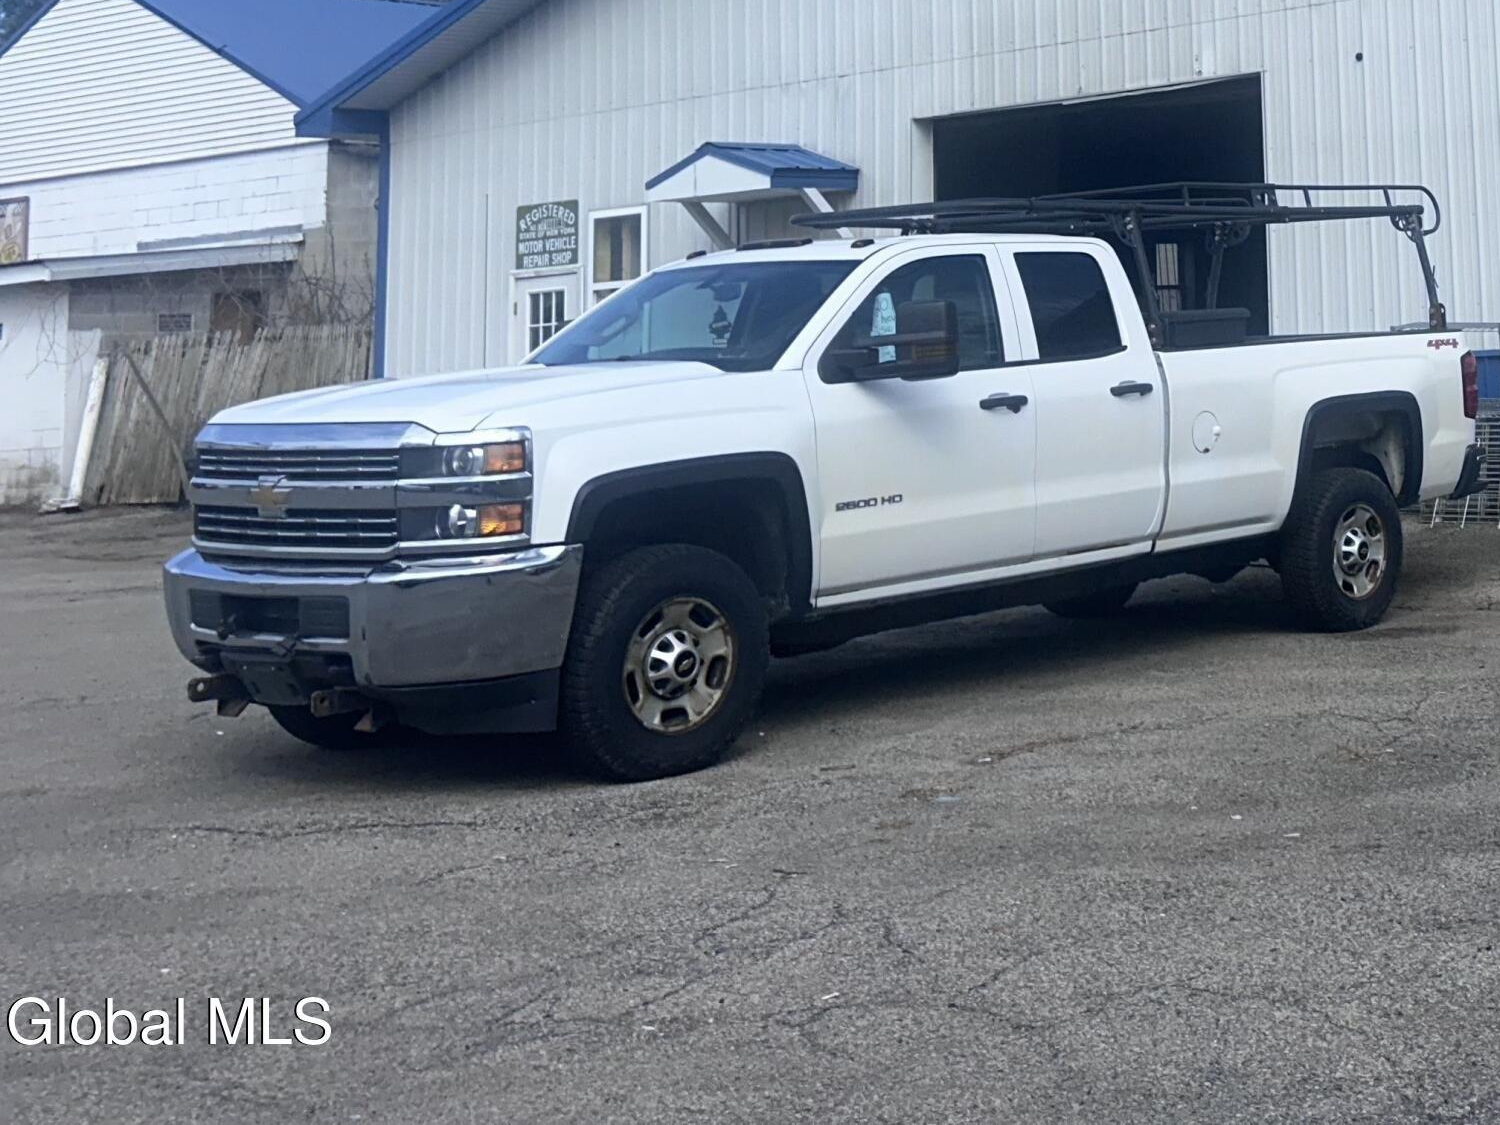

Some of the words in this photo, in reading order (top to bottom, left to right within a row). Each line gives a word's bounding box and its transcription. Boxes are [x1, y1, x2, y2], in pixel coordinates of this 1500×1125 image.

[519, 204, 576, 231] REGISTERED
[518, 240, 543, 254] MOTOR
[545, 236, 576, 251] VEHICLE
[523, 254, 549, 268] REPAIR
[552, 251, 572, 265] SHOP
[835, 498, 878, 512] 2500
[880, 494, 903, 506] HD
